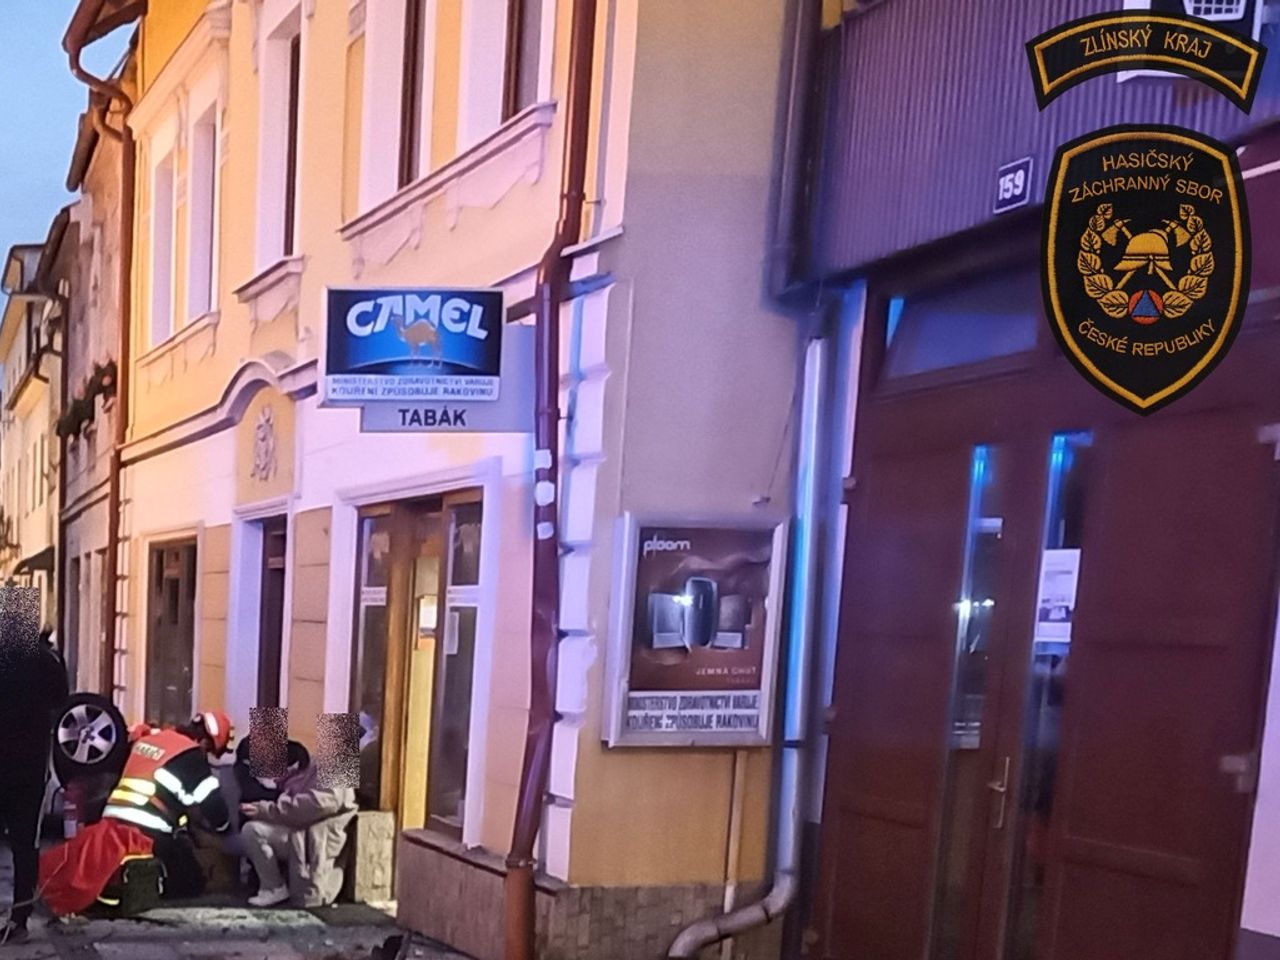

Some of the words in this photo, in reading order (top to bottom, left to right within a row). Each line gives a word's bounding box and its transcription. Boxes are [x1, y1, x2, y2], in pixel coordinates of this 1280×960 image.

[999, 169, 1025, 201] 159
[346, 294, 488, 340] CAMEL
[398, 405, 467, 427] TABÁK
[643, 533, 691, 558] ploom
